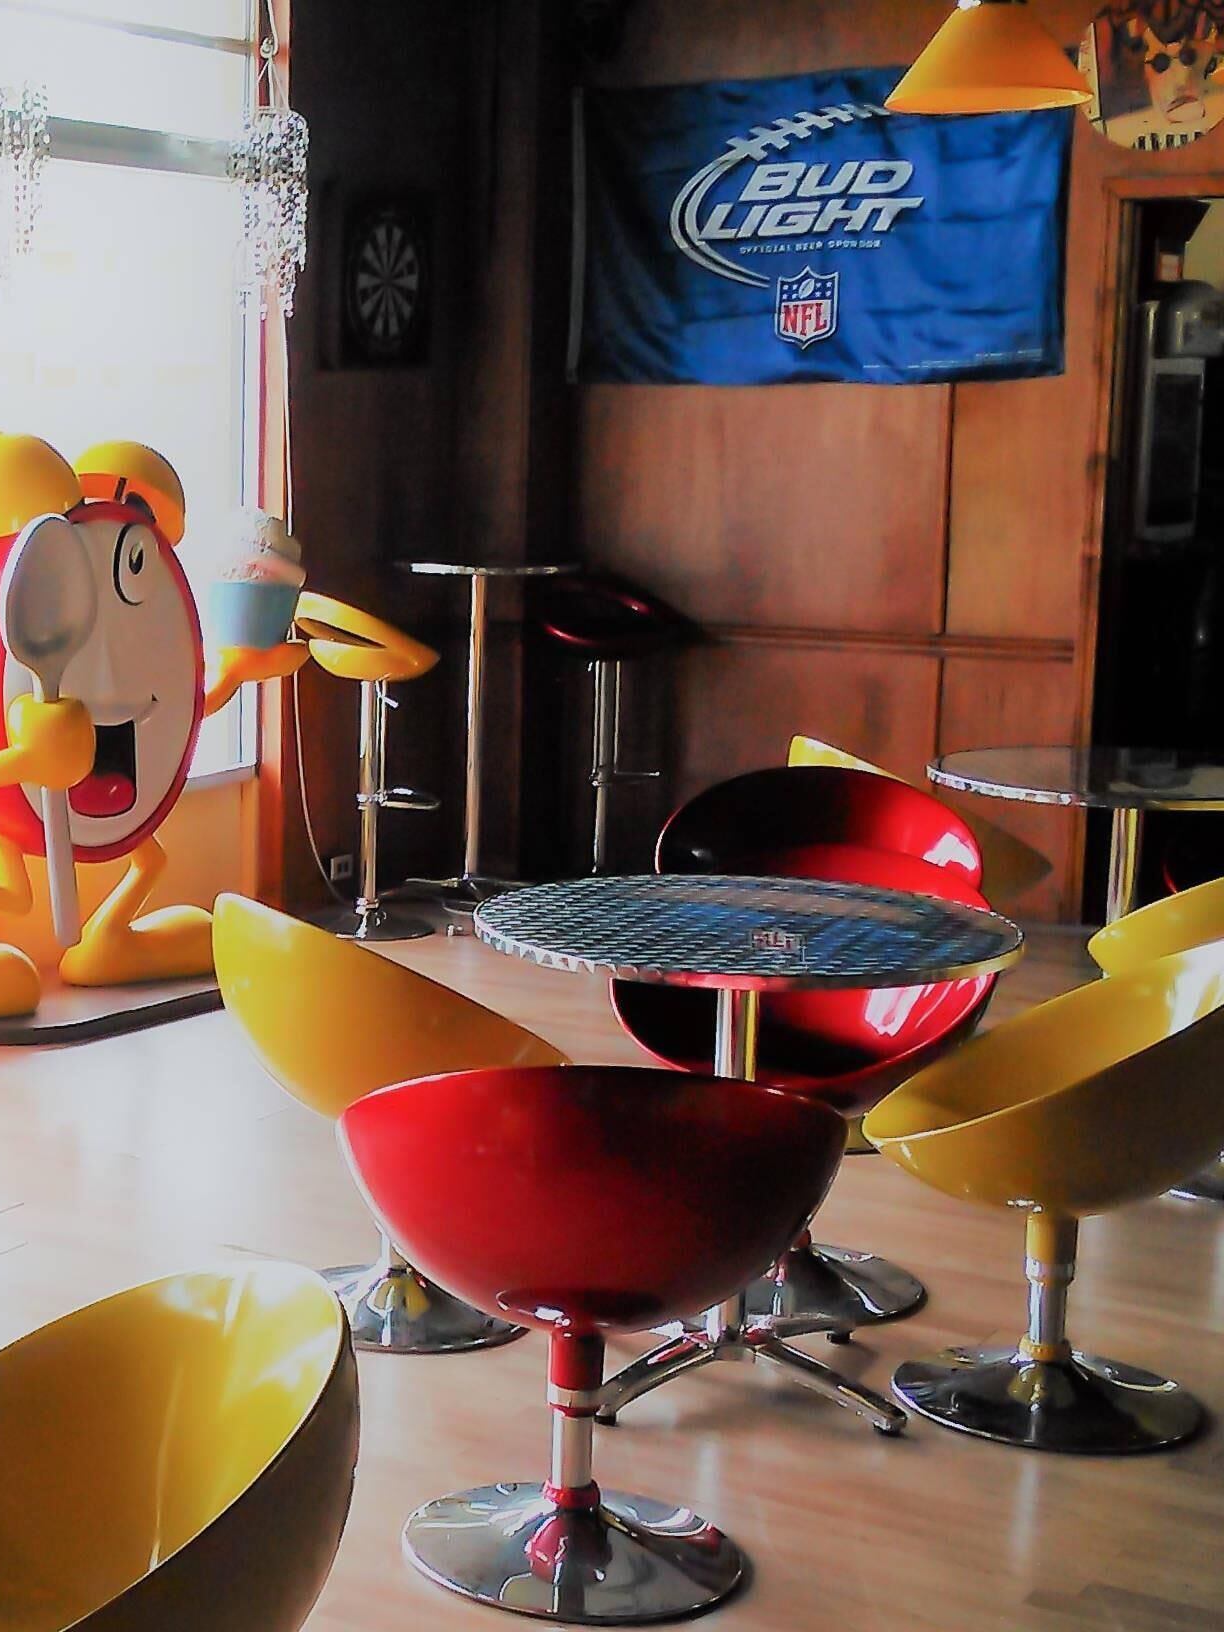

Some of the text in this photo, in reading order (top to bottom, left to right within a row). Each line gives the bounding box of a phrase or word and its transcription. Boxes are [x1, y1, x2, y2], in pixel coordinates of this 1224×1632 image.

[738, 160, 914, 201] BUD
[697, 196, 925, 240] LIGHT
[739, 239, 881, 255] OFFICIAL BEER SPONSOR
[782, 301, 828, 336] NFL
